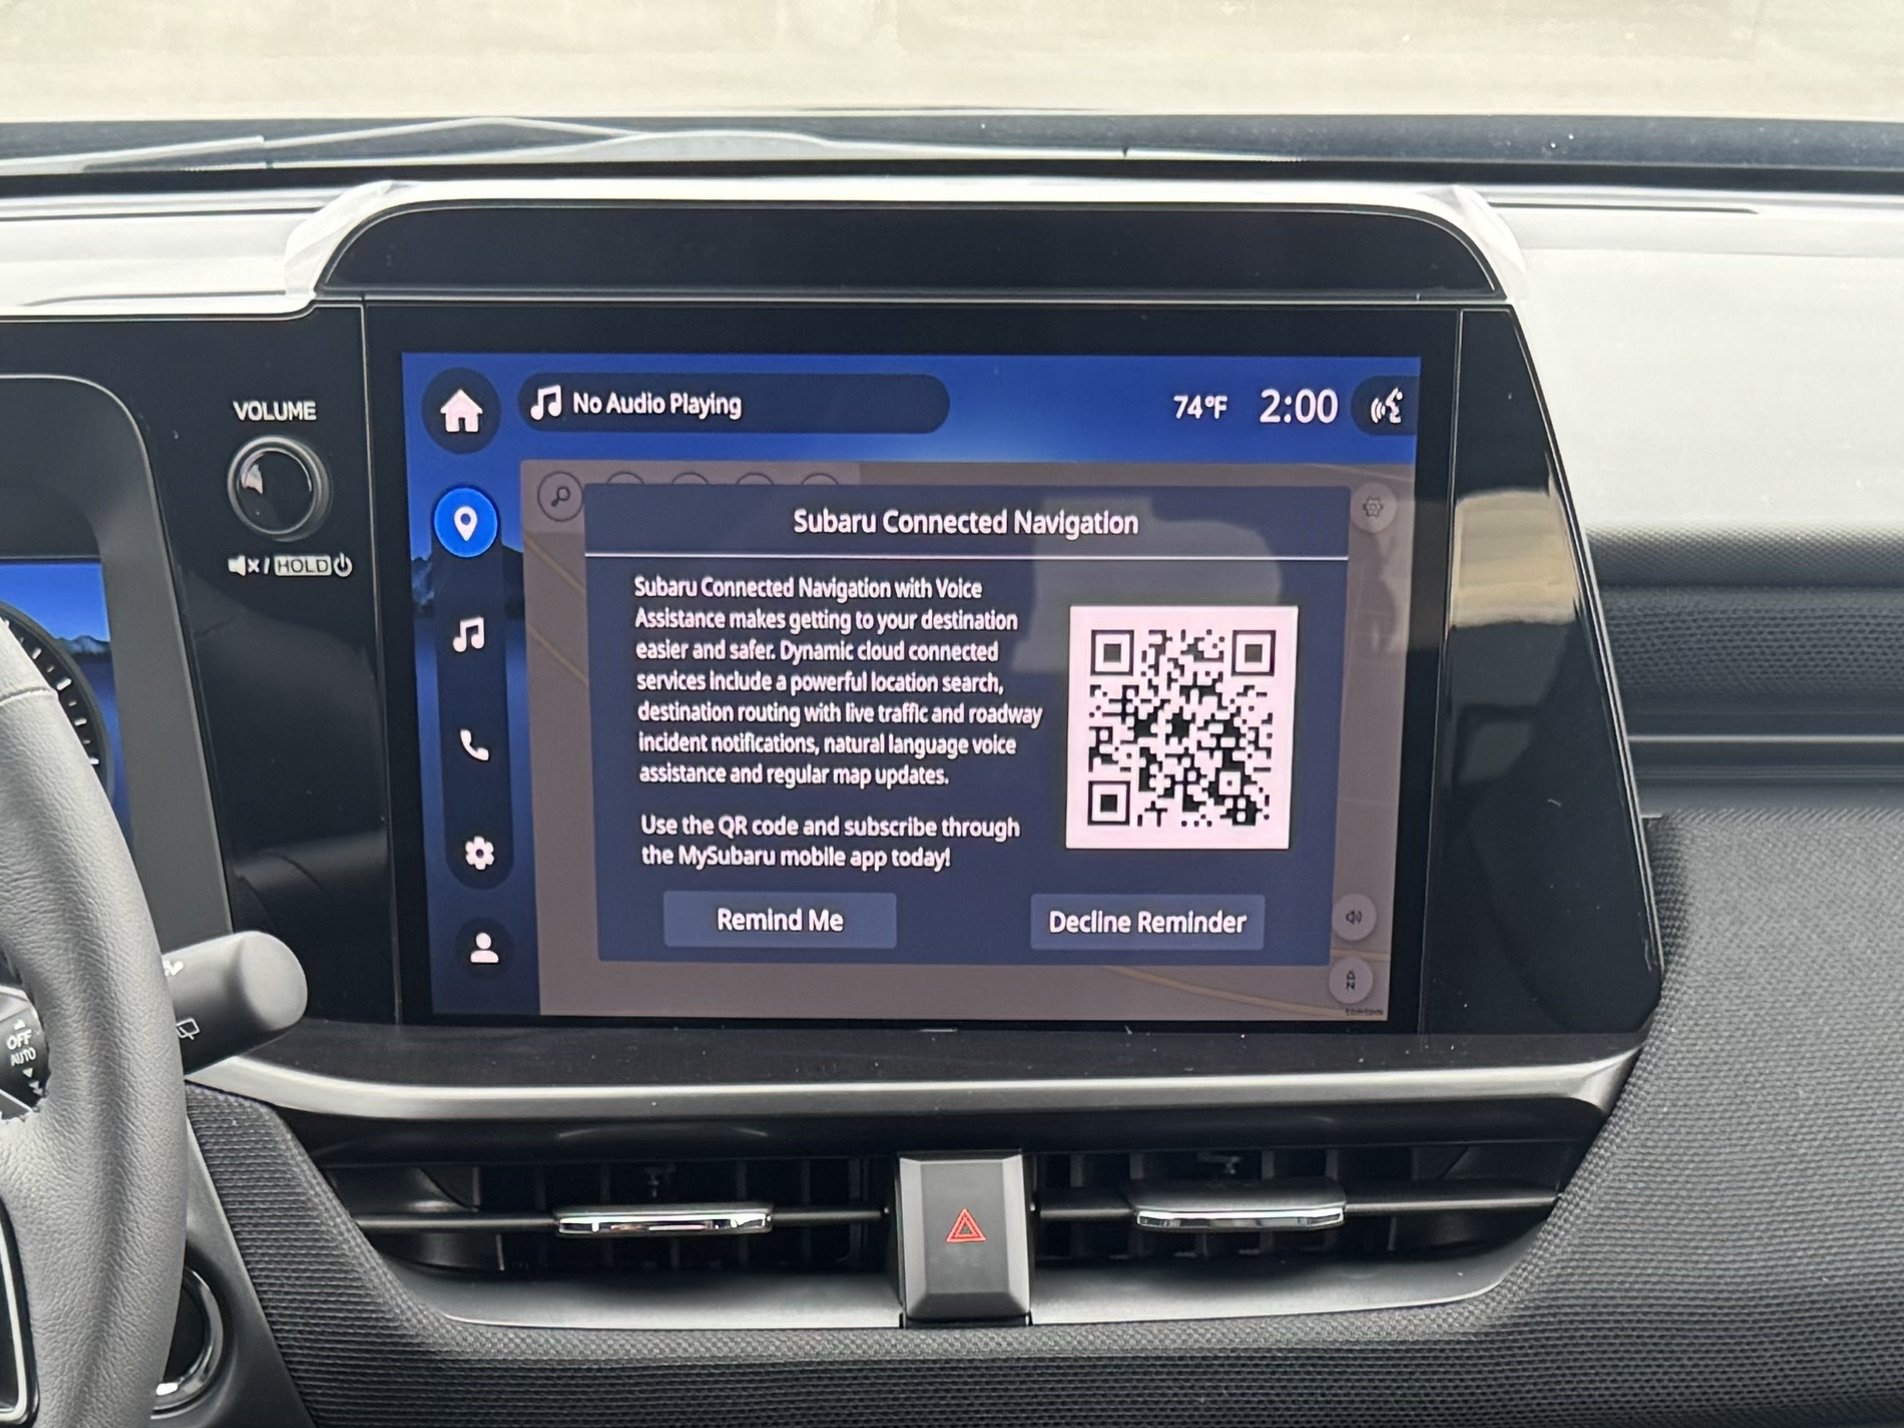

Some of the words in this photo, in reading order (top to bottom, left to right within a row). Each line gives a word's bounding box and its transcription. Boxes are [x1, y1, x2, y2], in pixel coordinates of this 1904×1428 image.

[233, 400, 316, 420] VOLUME
[573, 391, 602, 413] No
[606, 391, 665, 413] Audio
[670, 392, 741, 420] Playing
[1259, 388, 1338, 423] 2:00
[794, 507, 876, 533] Subaru
[882, 508, 1007, 534] Connected
[1014, 509, 1138, 540] Navigation
[277, 559, 329, 574] HOLD
[634, 575, 697, 596] Subaru
[701, 576, 794, 597] Connected
[798, 576, 891, 603] Navigation
[894, 577, 932, 598] with
[935, 577, 982, 598] Voice
[635, 607, 725, 628] Assistance
[729, 607, 786, 628] makes
[789, 608, 851, 635] getting
[855, 611, 874, 629] to
[876, 612, 918, 635] your
[921, 608, 1018, 630] destination
[635, 638, 689, 659] easier
[692, 638, 725, 659] and
[729, 638, 775, 660] safer.
[780, 639, 854, 665] Dynamic
[857, 639, 904, 660] cloud
[908, 640, 998, 661] connected
[636, 669, 706, 690] services
[709, 669, 772, 691] include
[775, 674, 786, 691] a
[790, 670, 867, 696] powerful
[871, 671, 938, 692] location
[942, 671, 1003, 695] search,
[637, 700, 734, 721] destination
[737, 701, 800, 727] routing
[803, 702, 841, 722] with
[845, 702, 874, 722] live
[877, 701, 928, 723] traffic
[931, 702, 964, 723] and
[968, 702, 1043, 729] roadway
[638, 731, 708, 752] incident
[711, 731, 820, 755] notifications,
[824, 732, 885, 753] natural
[888, 733, 969, 759] language
[971, 733, 1016, 754] voice
[639, 762, 727, 783] assistance
[730, 762, 763, 783] and
[766, 763, 830, 789] regular
[833, 767, 871, 789] map
[875, 764, 949, 790] updates.
[641, 814, 678, 835] Use
[681, 814, 714, 835] the
[718, 815, 748, 839] QR
[752, 815, 799, 835] code
[803, 815, 840, 836] and
[844, 815, 937, 836] subscribe
[941, 816, 1020, 842] through
[641, 844, 674, 865] the
[678, 845, 775, 870] MySubaru
[780, 845, 846, 866] mobile
[849, 850, 887, 872] app
[891, 846, 950, 872] today!
[718, 907, 802, 931] Remind
[808, 908, 843, 931] Me
[1049, 909, 1131, 933] Decline
[1137, 910, 1247, 933] Reminder
[6, 1029, 33, 1050] OFF
[10, 1046, 36, 1067] AUTO
